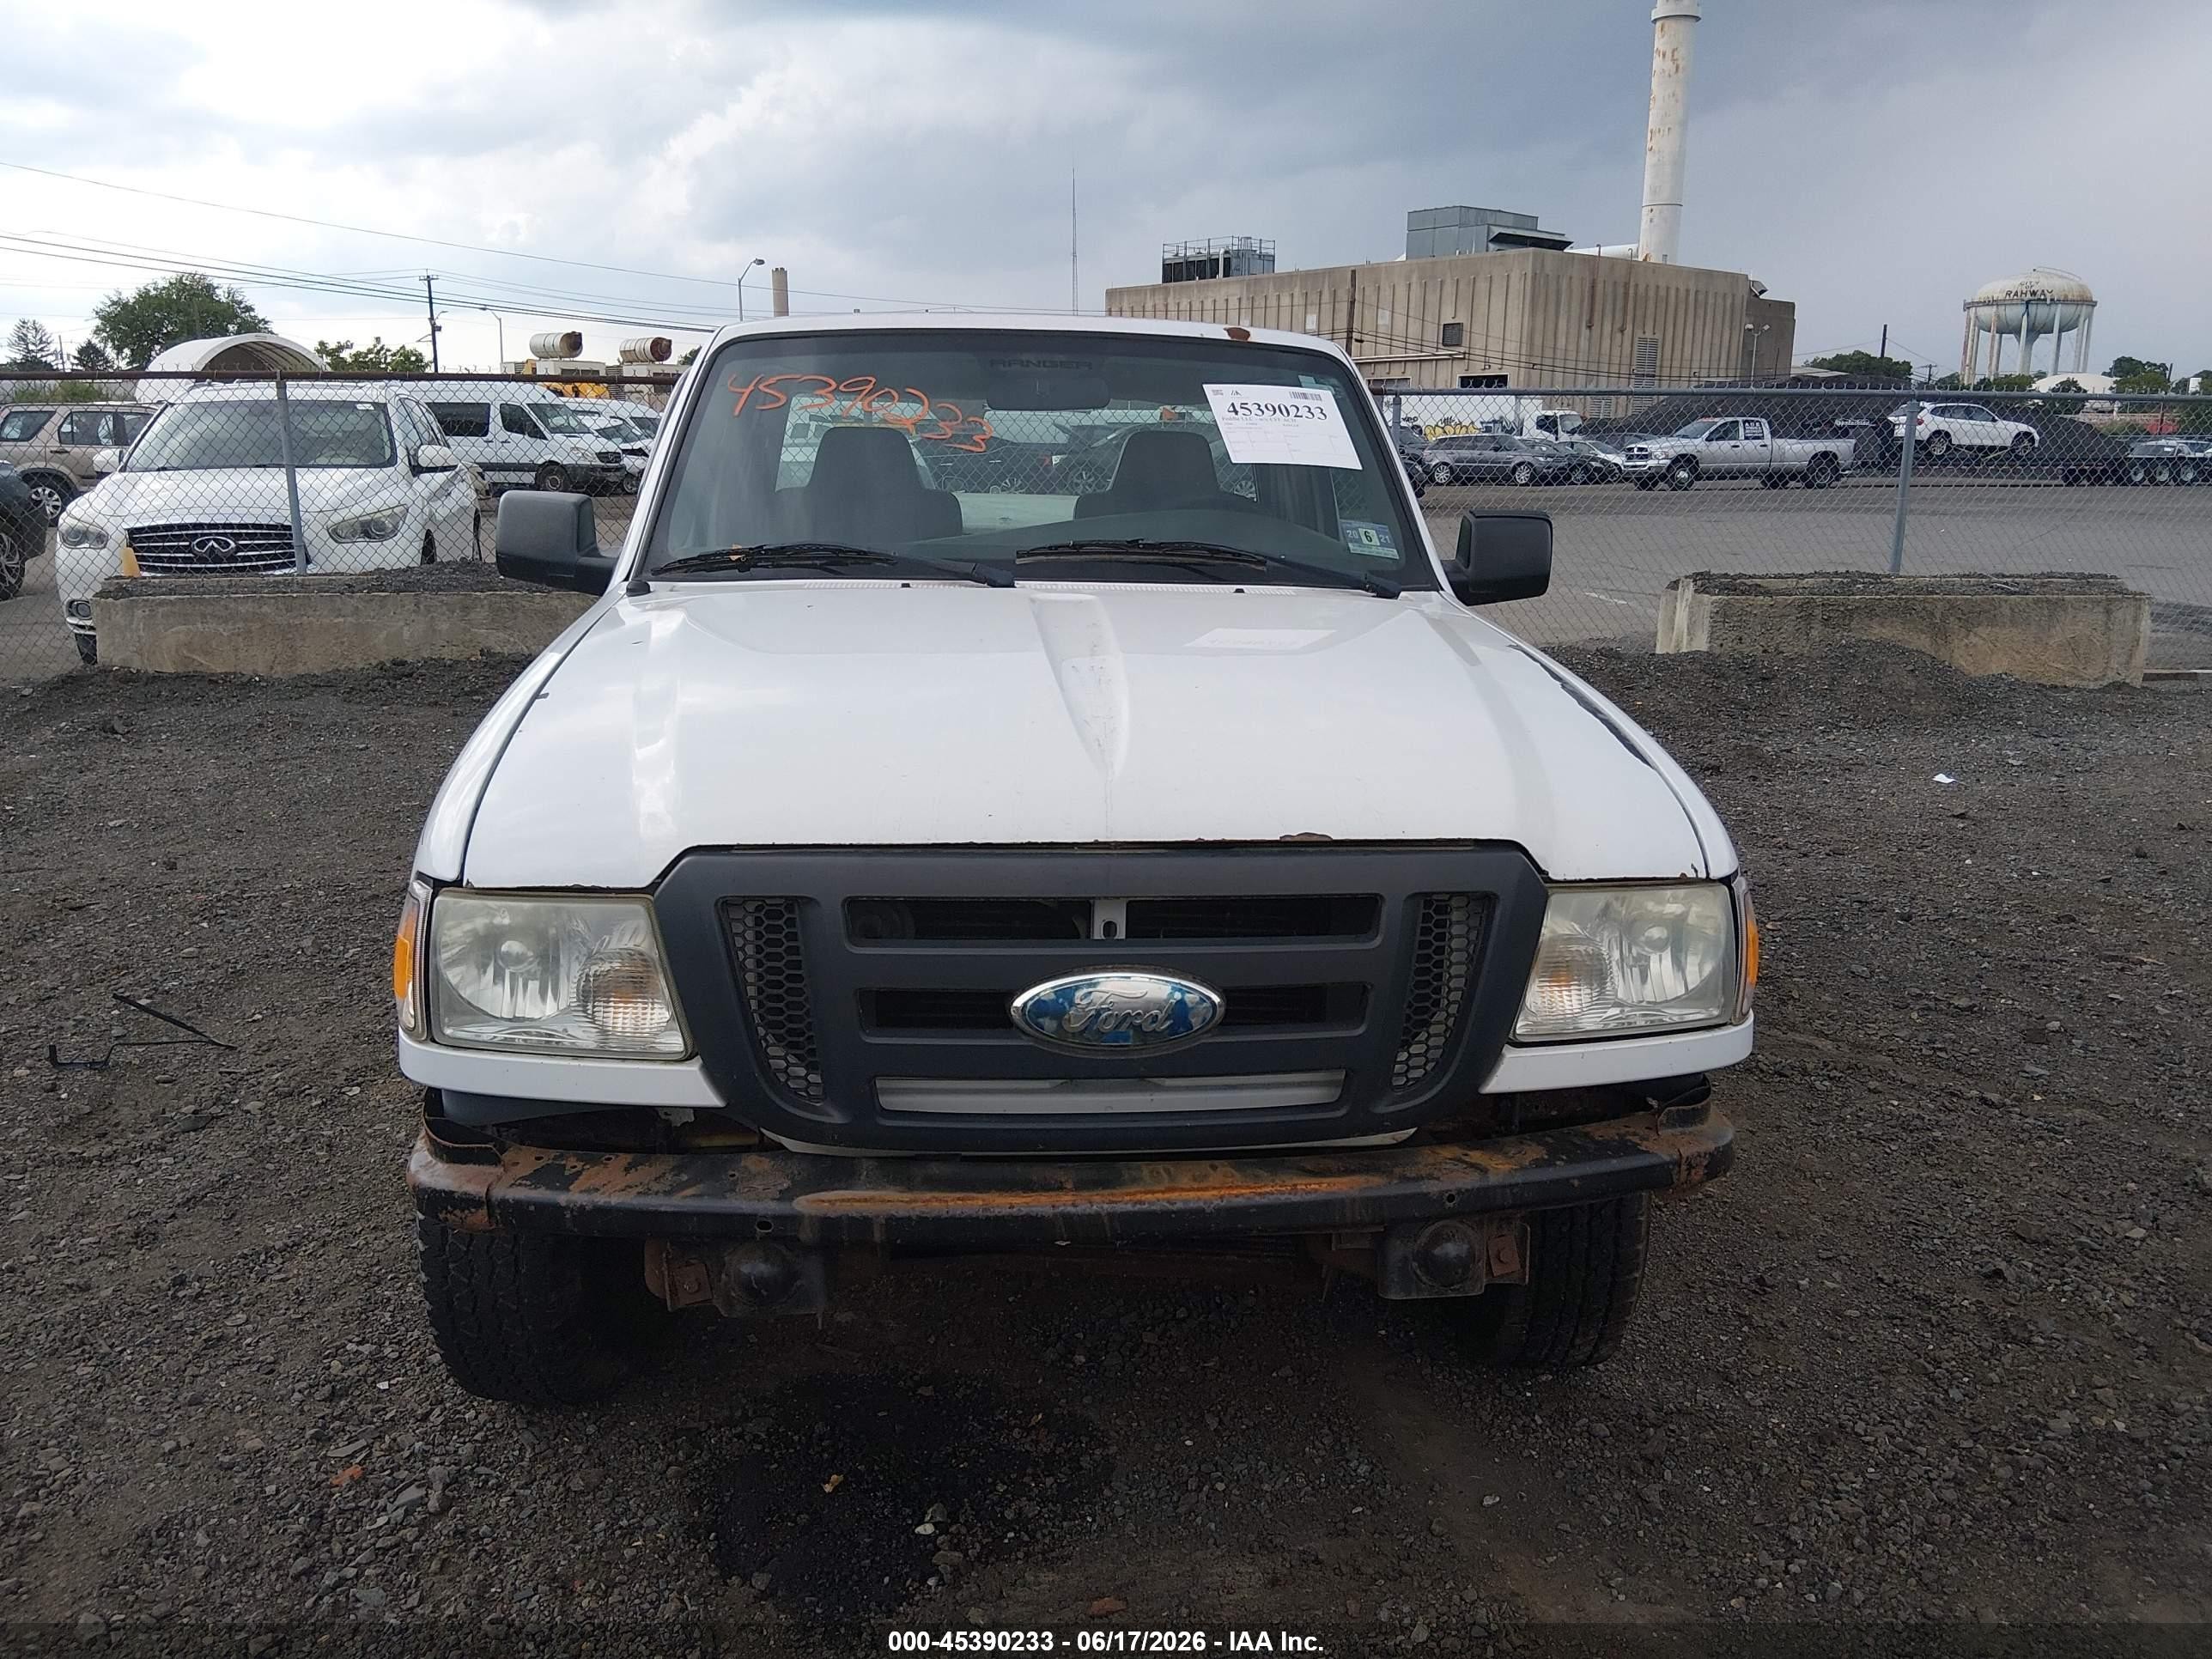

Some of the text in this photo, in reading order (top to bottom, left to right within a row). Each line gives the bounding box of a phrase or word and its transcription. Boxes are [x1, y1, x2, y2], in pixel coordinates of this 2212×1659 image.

[2005, 289, 2054, 299] RAHWAY
[989, 357, 1093, 369] RANGER
[1226, 401, 1328, 421] 45390233
[1364, 530, 1373, 543] 6
[1061, 988, 1176, 1033] Ford
